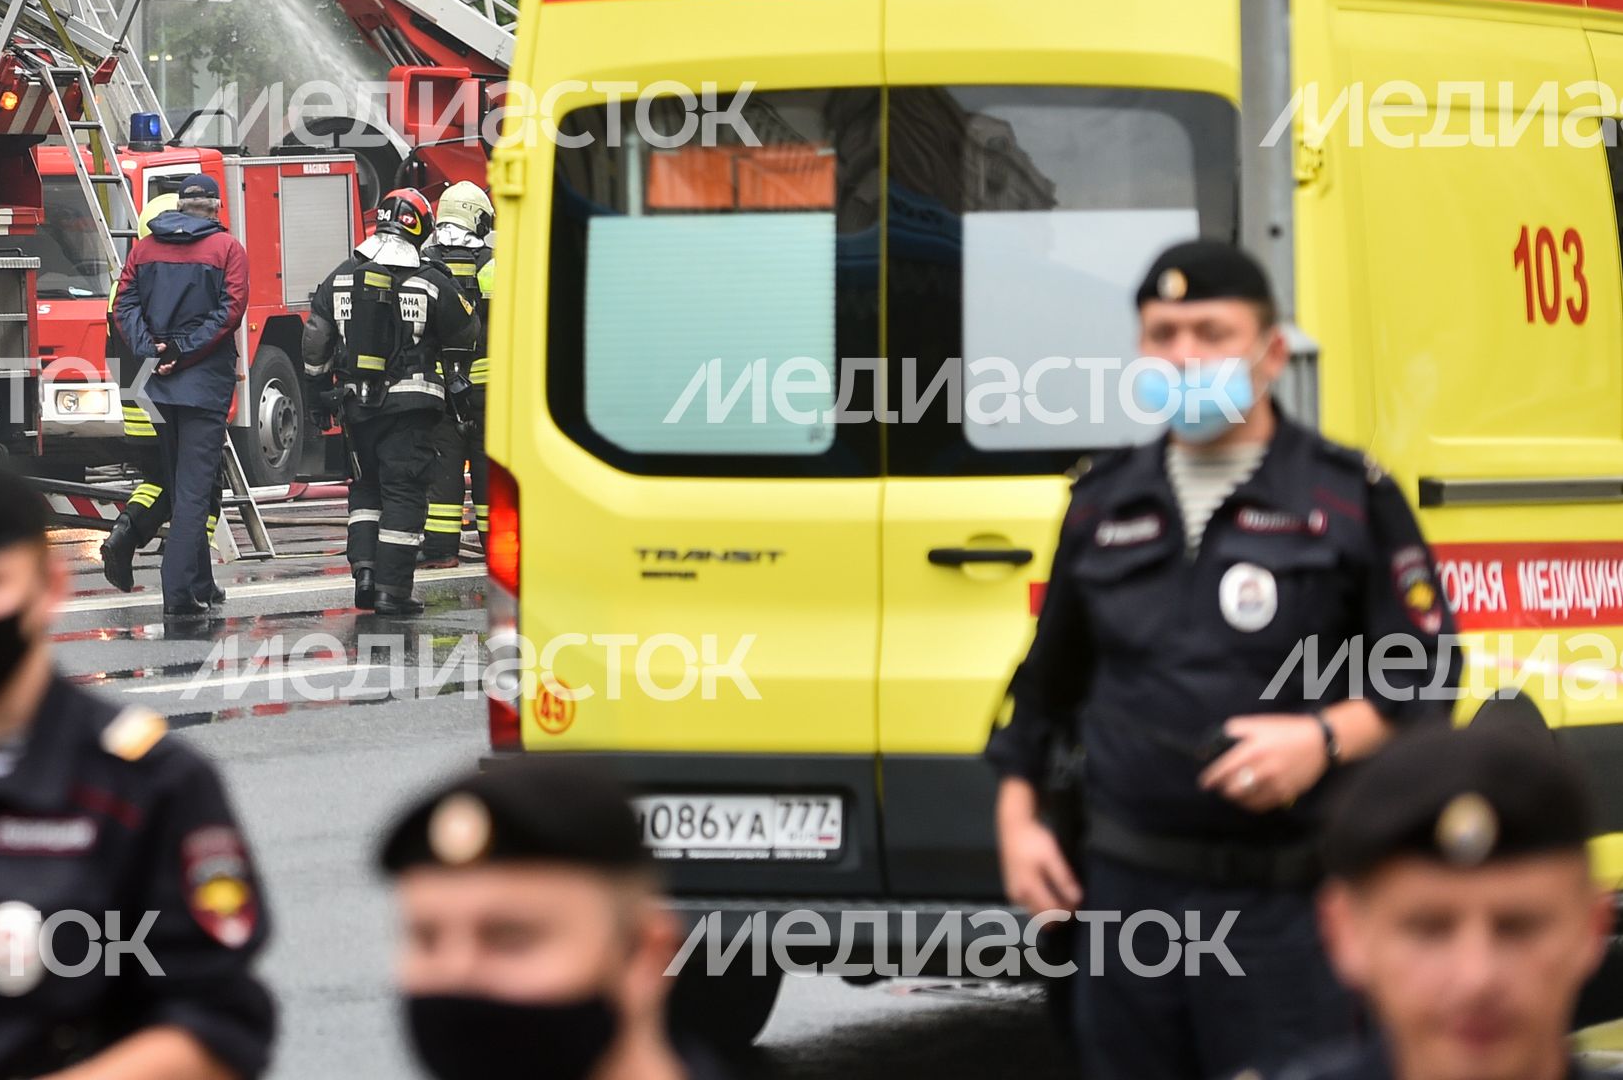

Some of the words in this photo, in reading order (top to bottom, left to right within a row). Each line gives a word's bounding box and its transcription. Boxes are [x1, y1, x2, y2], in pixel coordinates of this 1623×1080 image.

[1513, 224, 1590, 326] 103
[398, 296, 420, 307] РАНА
[635, 548, 786, 564] TRANSIT
[1436, 559, 1509, 614] ОРАЯ
[778, 802, 831, 831] 777
